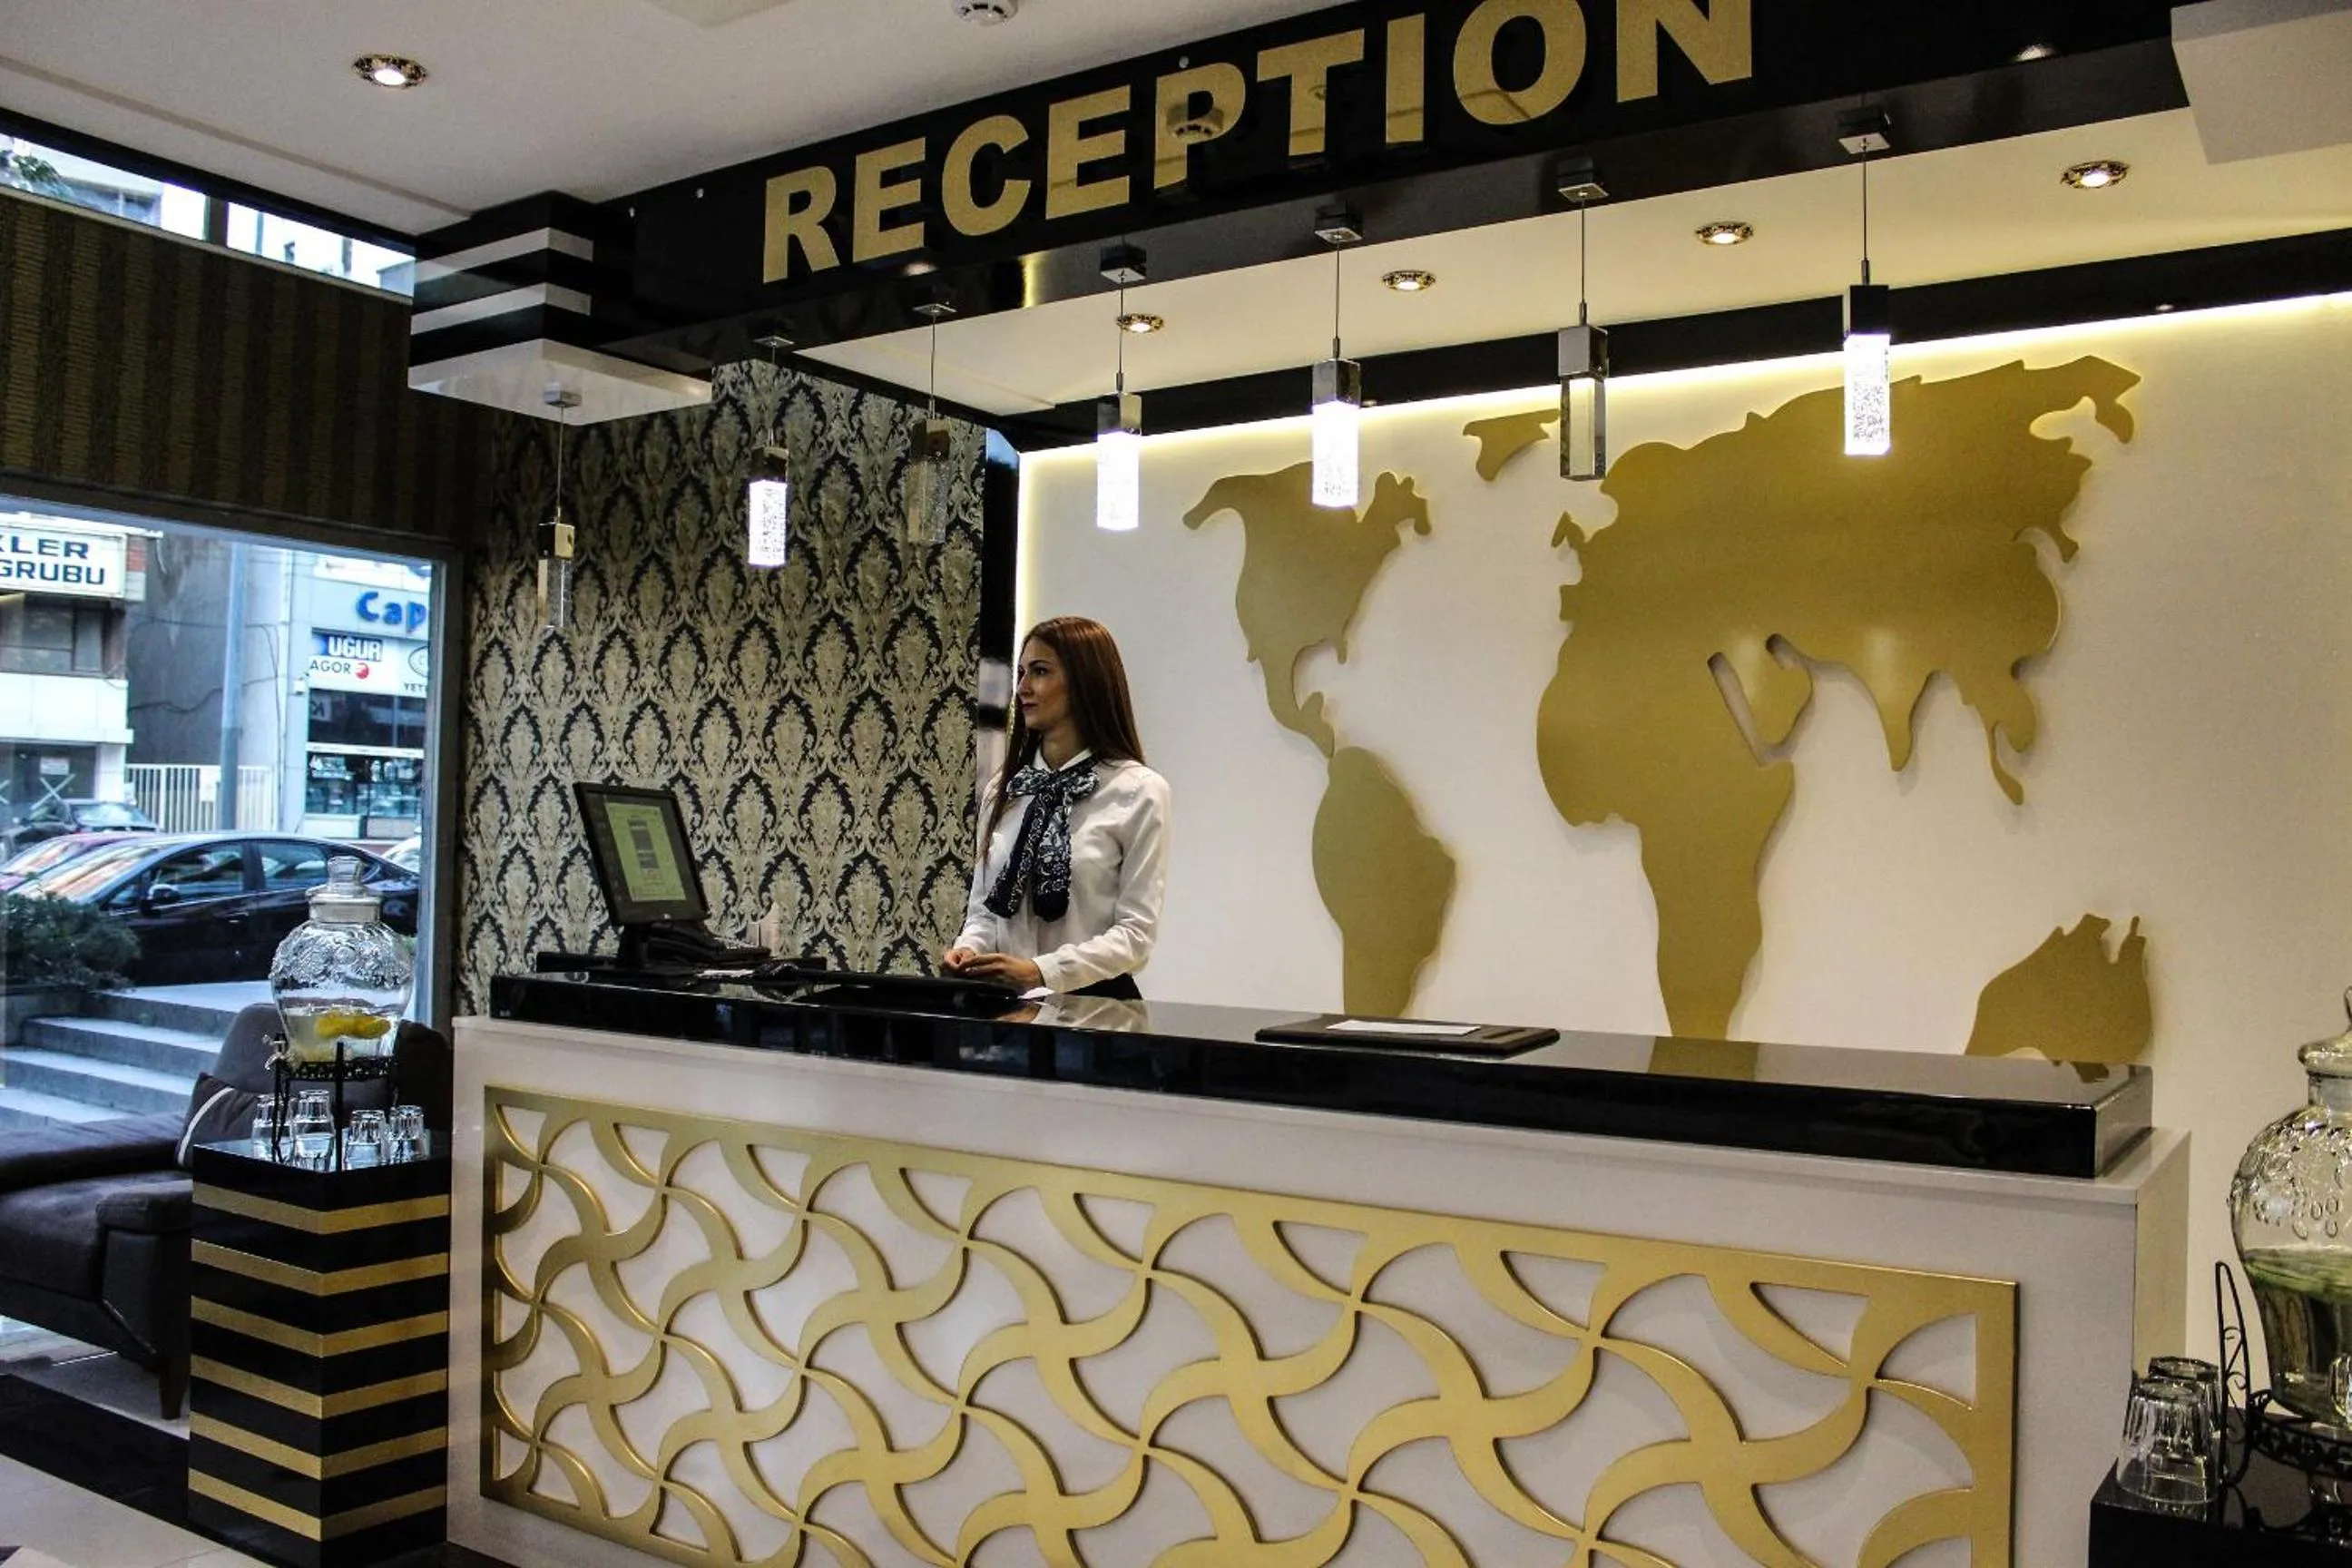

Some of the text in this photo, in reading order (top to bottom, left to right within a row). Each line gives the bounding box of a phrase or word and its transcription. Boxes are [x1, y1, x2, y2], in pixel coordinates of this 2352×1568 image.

[762, 0, 1753, 284] RECEPTION
[0, 534, 89, 559] LER
[0, 559, 104, 585] GRUBU
